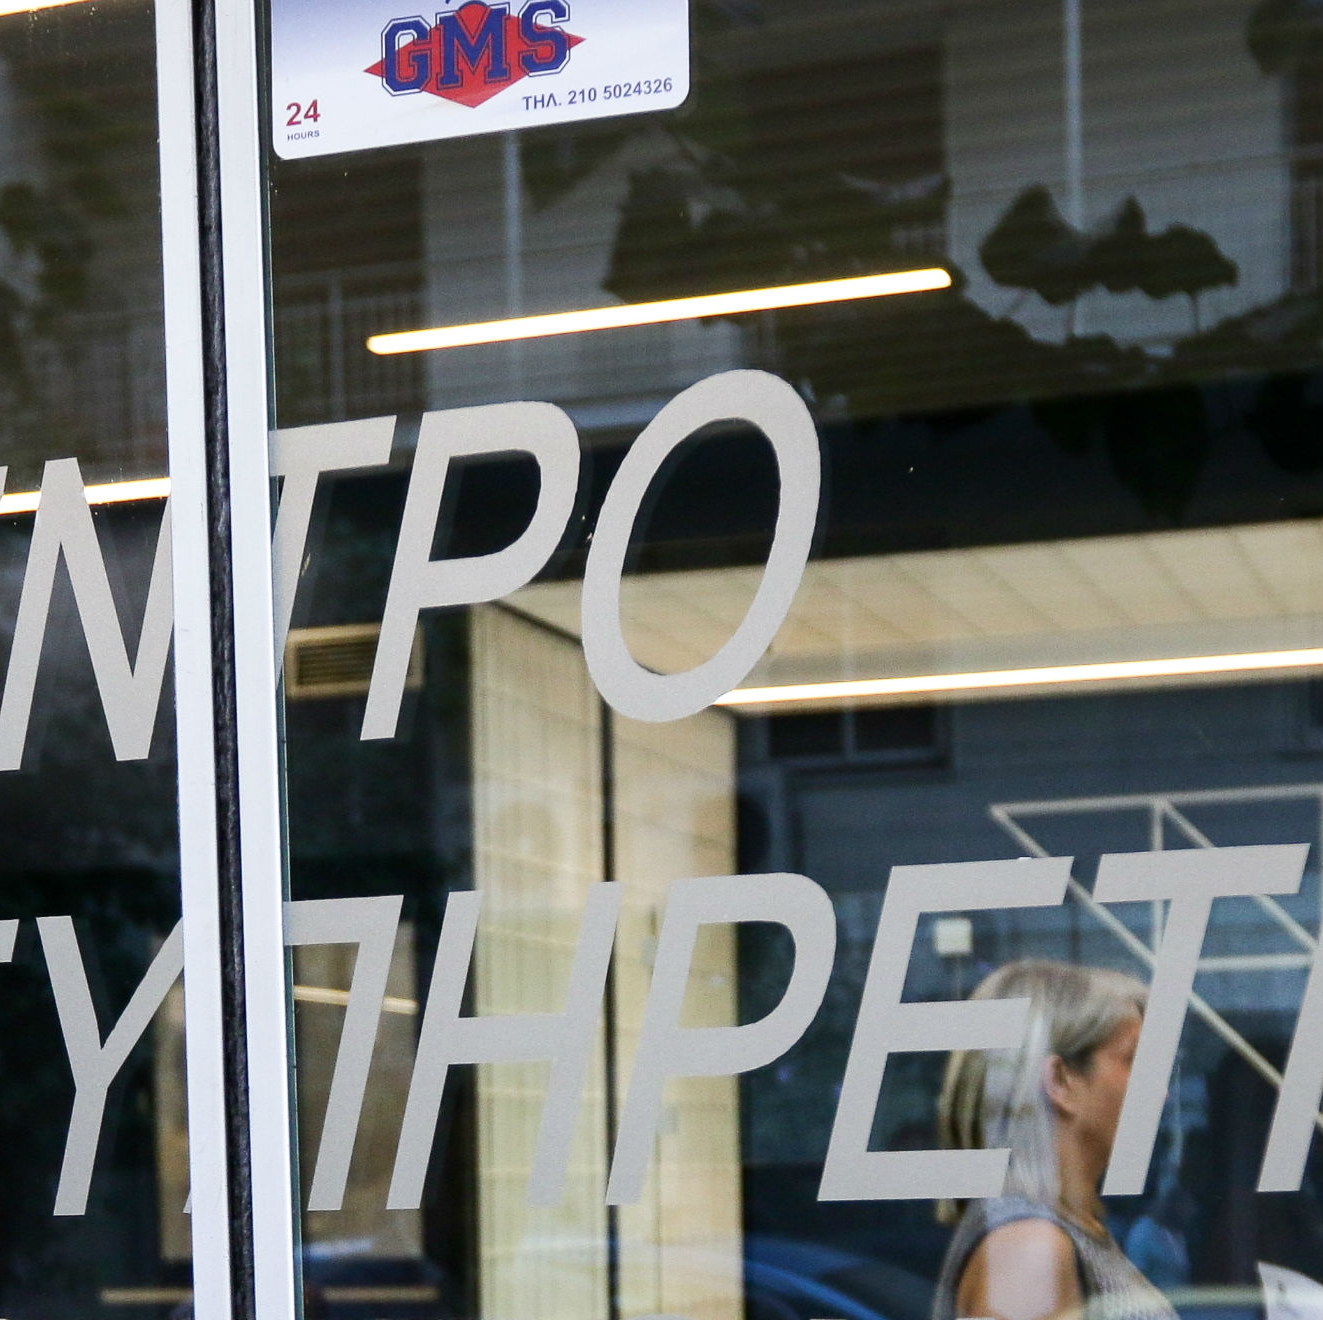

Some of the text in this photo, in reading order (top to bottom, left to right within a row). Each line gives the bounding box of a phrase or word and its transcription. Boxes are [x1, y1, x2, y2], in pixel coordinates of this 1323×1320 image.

[380, 0, 572, 97] GMS
[522, 77, 674, 111] ΤΗΛ. 210 5024326
[285, 99, 322, 127] 24
[287, 130, 321, 142] HOURS
